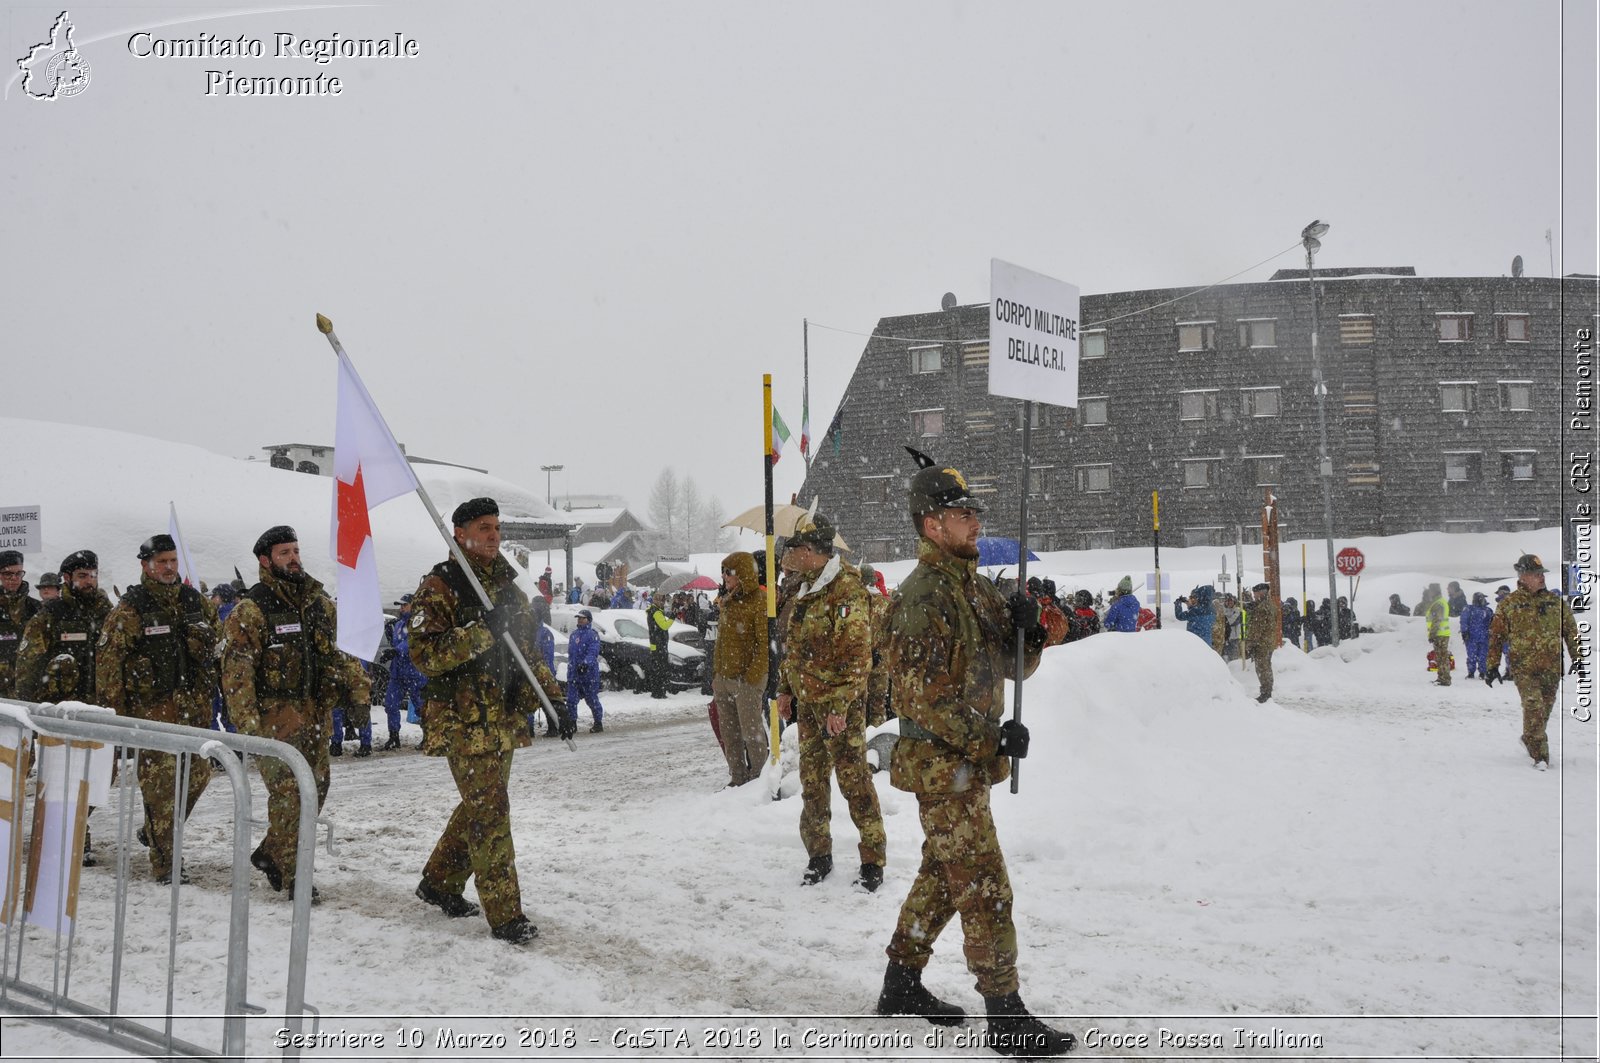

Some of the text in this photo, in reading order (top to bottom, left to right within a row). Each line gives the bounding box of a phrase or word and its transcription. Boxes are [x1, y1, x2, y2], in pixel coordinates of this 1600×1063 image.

[996, 298, 1077, 341] CORPO MILITARE
[1008, 337, 1066, 372] DELLA C.R.I.
[2, 512, 38, 522] INFERMIERE
[1337, 556, 1363, 567] STOP
